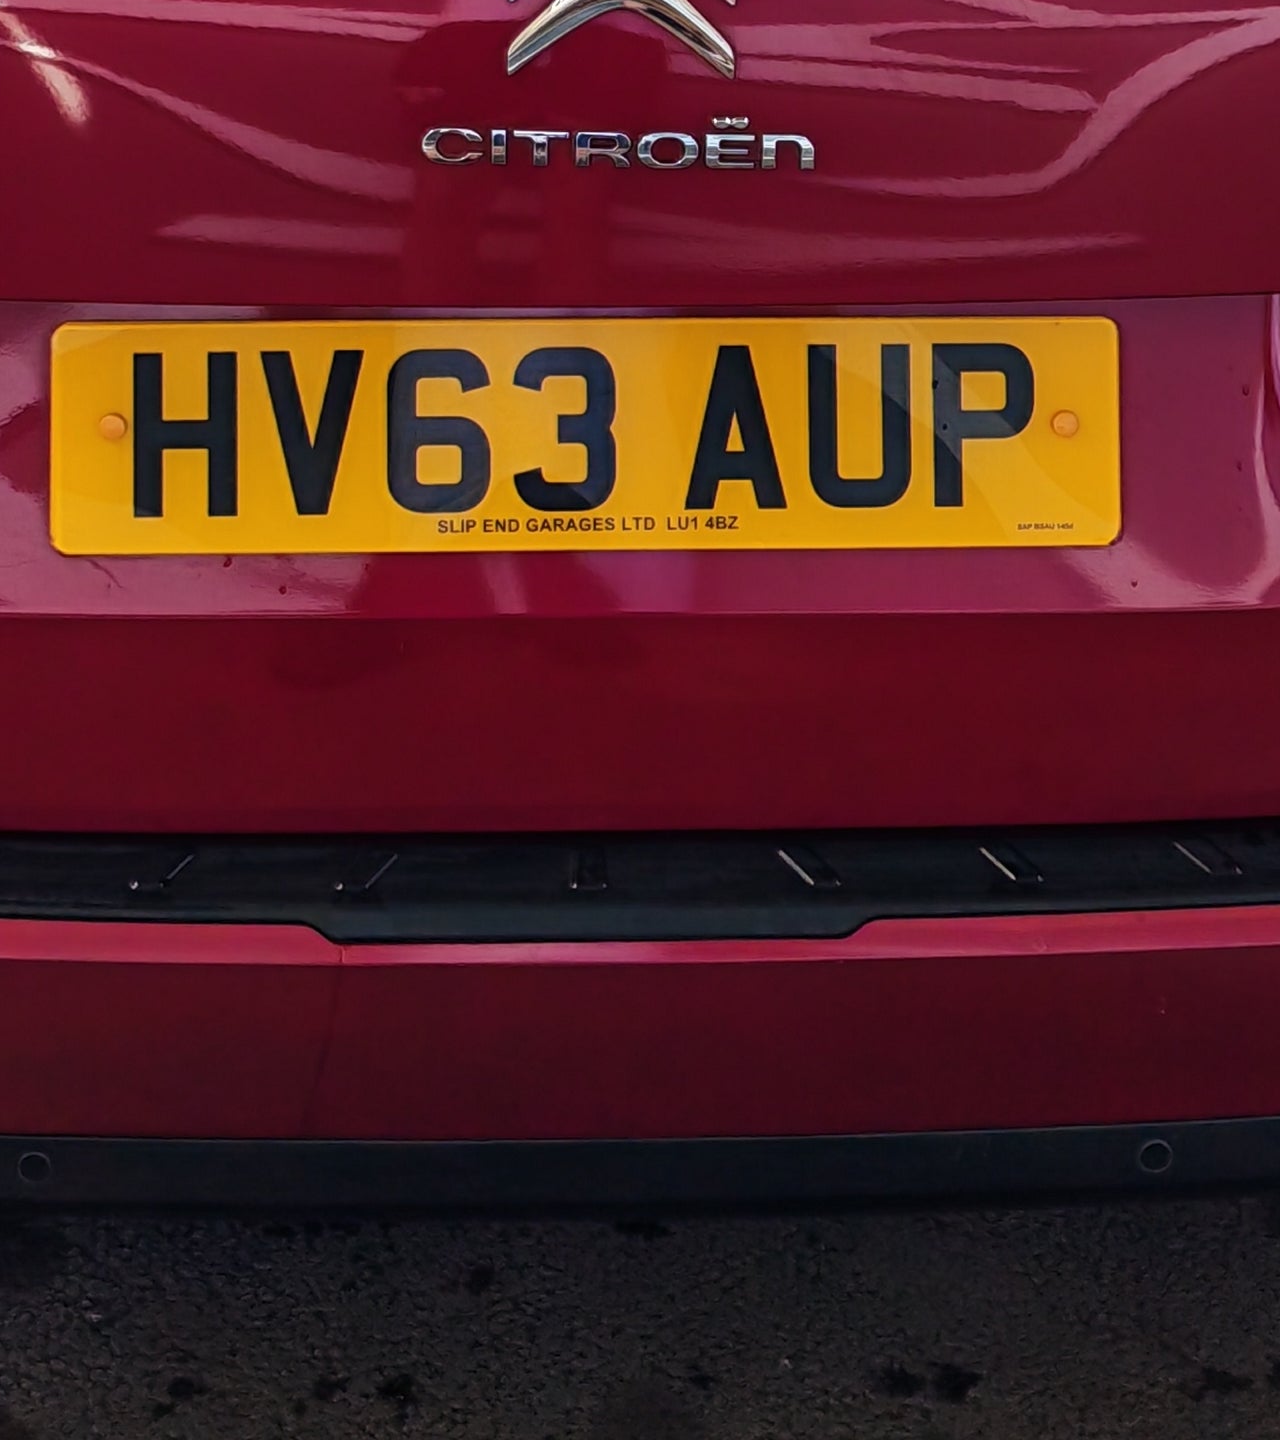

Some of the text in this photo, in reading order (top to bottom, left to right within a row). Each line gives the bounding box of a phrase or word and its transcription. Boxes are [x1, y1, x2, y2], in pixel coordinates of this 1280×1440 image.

[132, 343, 1035, 518] HV63 AUP
[437, 515, 739, 534] SLIP END GARAGES LTD LU1 4BZ
